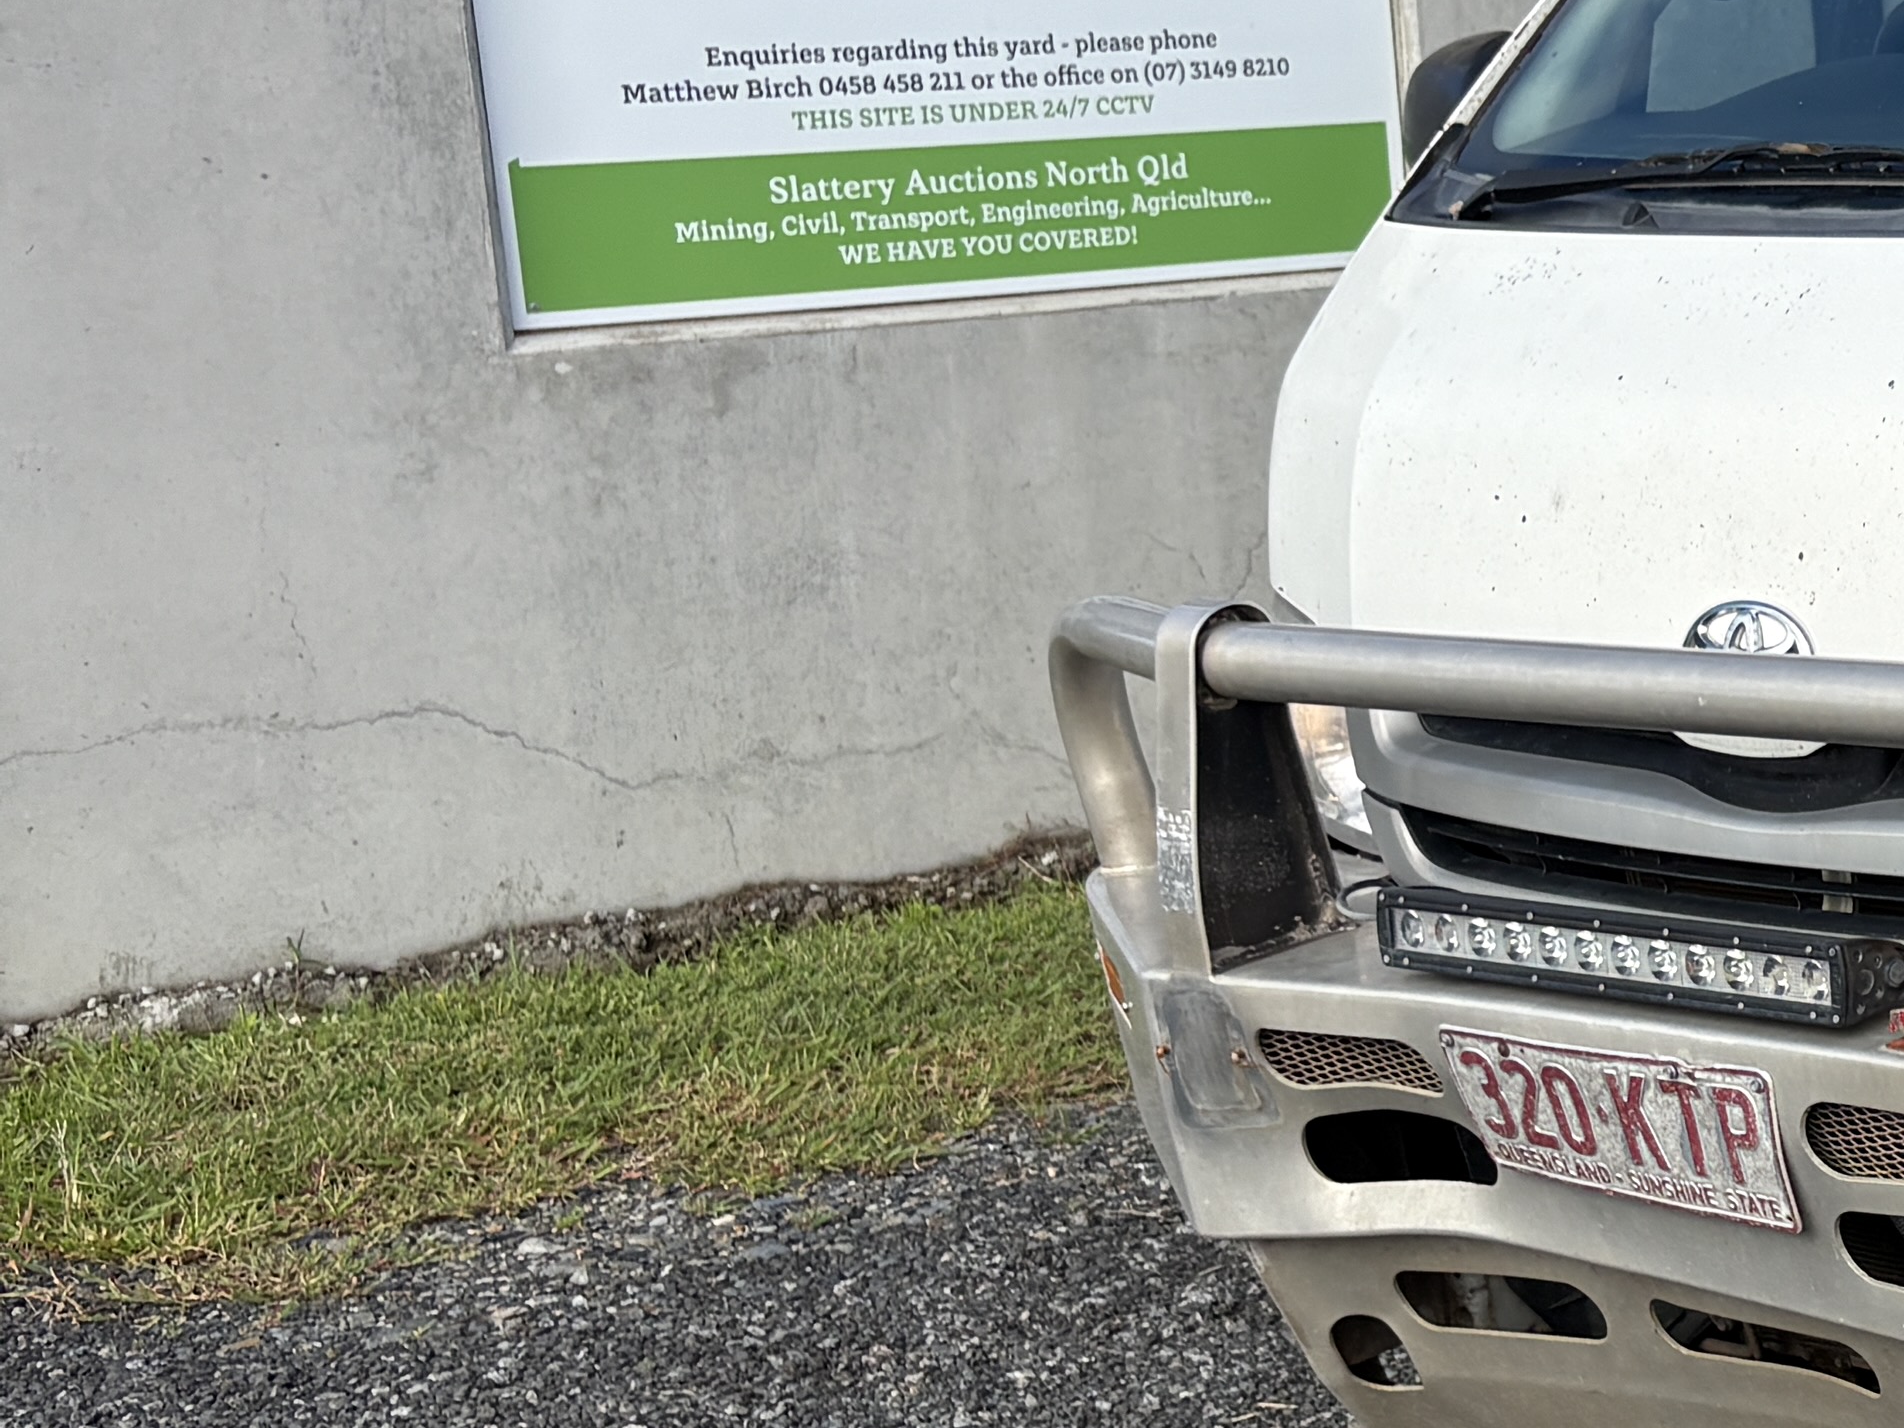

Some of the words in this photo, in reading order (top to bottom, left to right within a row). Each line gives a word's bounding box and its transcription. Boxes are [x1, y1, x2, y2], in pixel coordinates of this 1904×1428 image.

[705, 42, 825, 71] Enquiries
[832, 38, 948, 66] regarding
[954, 36, 999, 58] this
[1004, 33, 1056, 61] yard
[1075, 31, 1144, 58] please
[1151, 29, 1217, 56] phone
[621, 79, 739, 104] Matthew
[745, 75, 812, 100] Birch
[819, 74, 877, 97] 0458
[883, 73, 924, 93] 458
[930, 72, 965, 91] 211
[971, 73, 995, 91] or
[1001, 66, 1038, 89] the
[1044, 64, 1104, 87] office
[1111, 66, 1139, 84] on
[1144, 59, 1186, 87] (07)
[1190, 60, 1237, 81] 3149
[1242, 57, 1290, 77] 8210
[791, 108, 852, 131] THIS
[858, 106, 915, 128] SITE
[922, 104, 944, 125] IS
[949, 100, 1039, 123] UNDER
[1042, 95, 1090, 120] 24/7
[1096, 95, 1155, 116] CCTV
[769, 174, 895, 205] Slattery
[905, 166, 1038, 196] Auctions
[1045, 157, 1130, 188] North
[1137, 152, 1189, 187] Qld
[674, 217, 776, 244] Mining,
[781, 211, 846, 237] Civil,
[850, 205, 976, 232] Transport,
[981, 196, 1126, 226] Engineering,
[1131, 187, 1272, 217] Agriculture...
[838, 242, 882, 265] WE
[886, 238, 957, 262] HAVE
[961, 234, 1013, 257] YOU
[1019, 225, 1139, 253] COVERED!
[1499, 1142, 1611, 1183] QUEENSLAND
[1628, 1171, 1718, 1206] SUNSHINE
[1727, 1187, 1785, 1221] STATE
